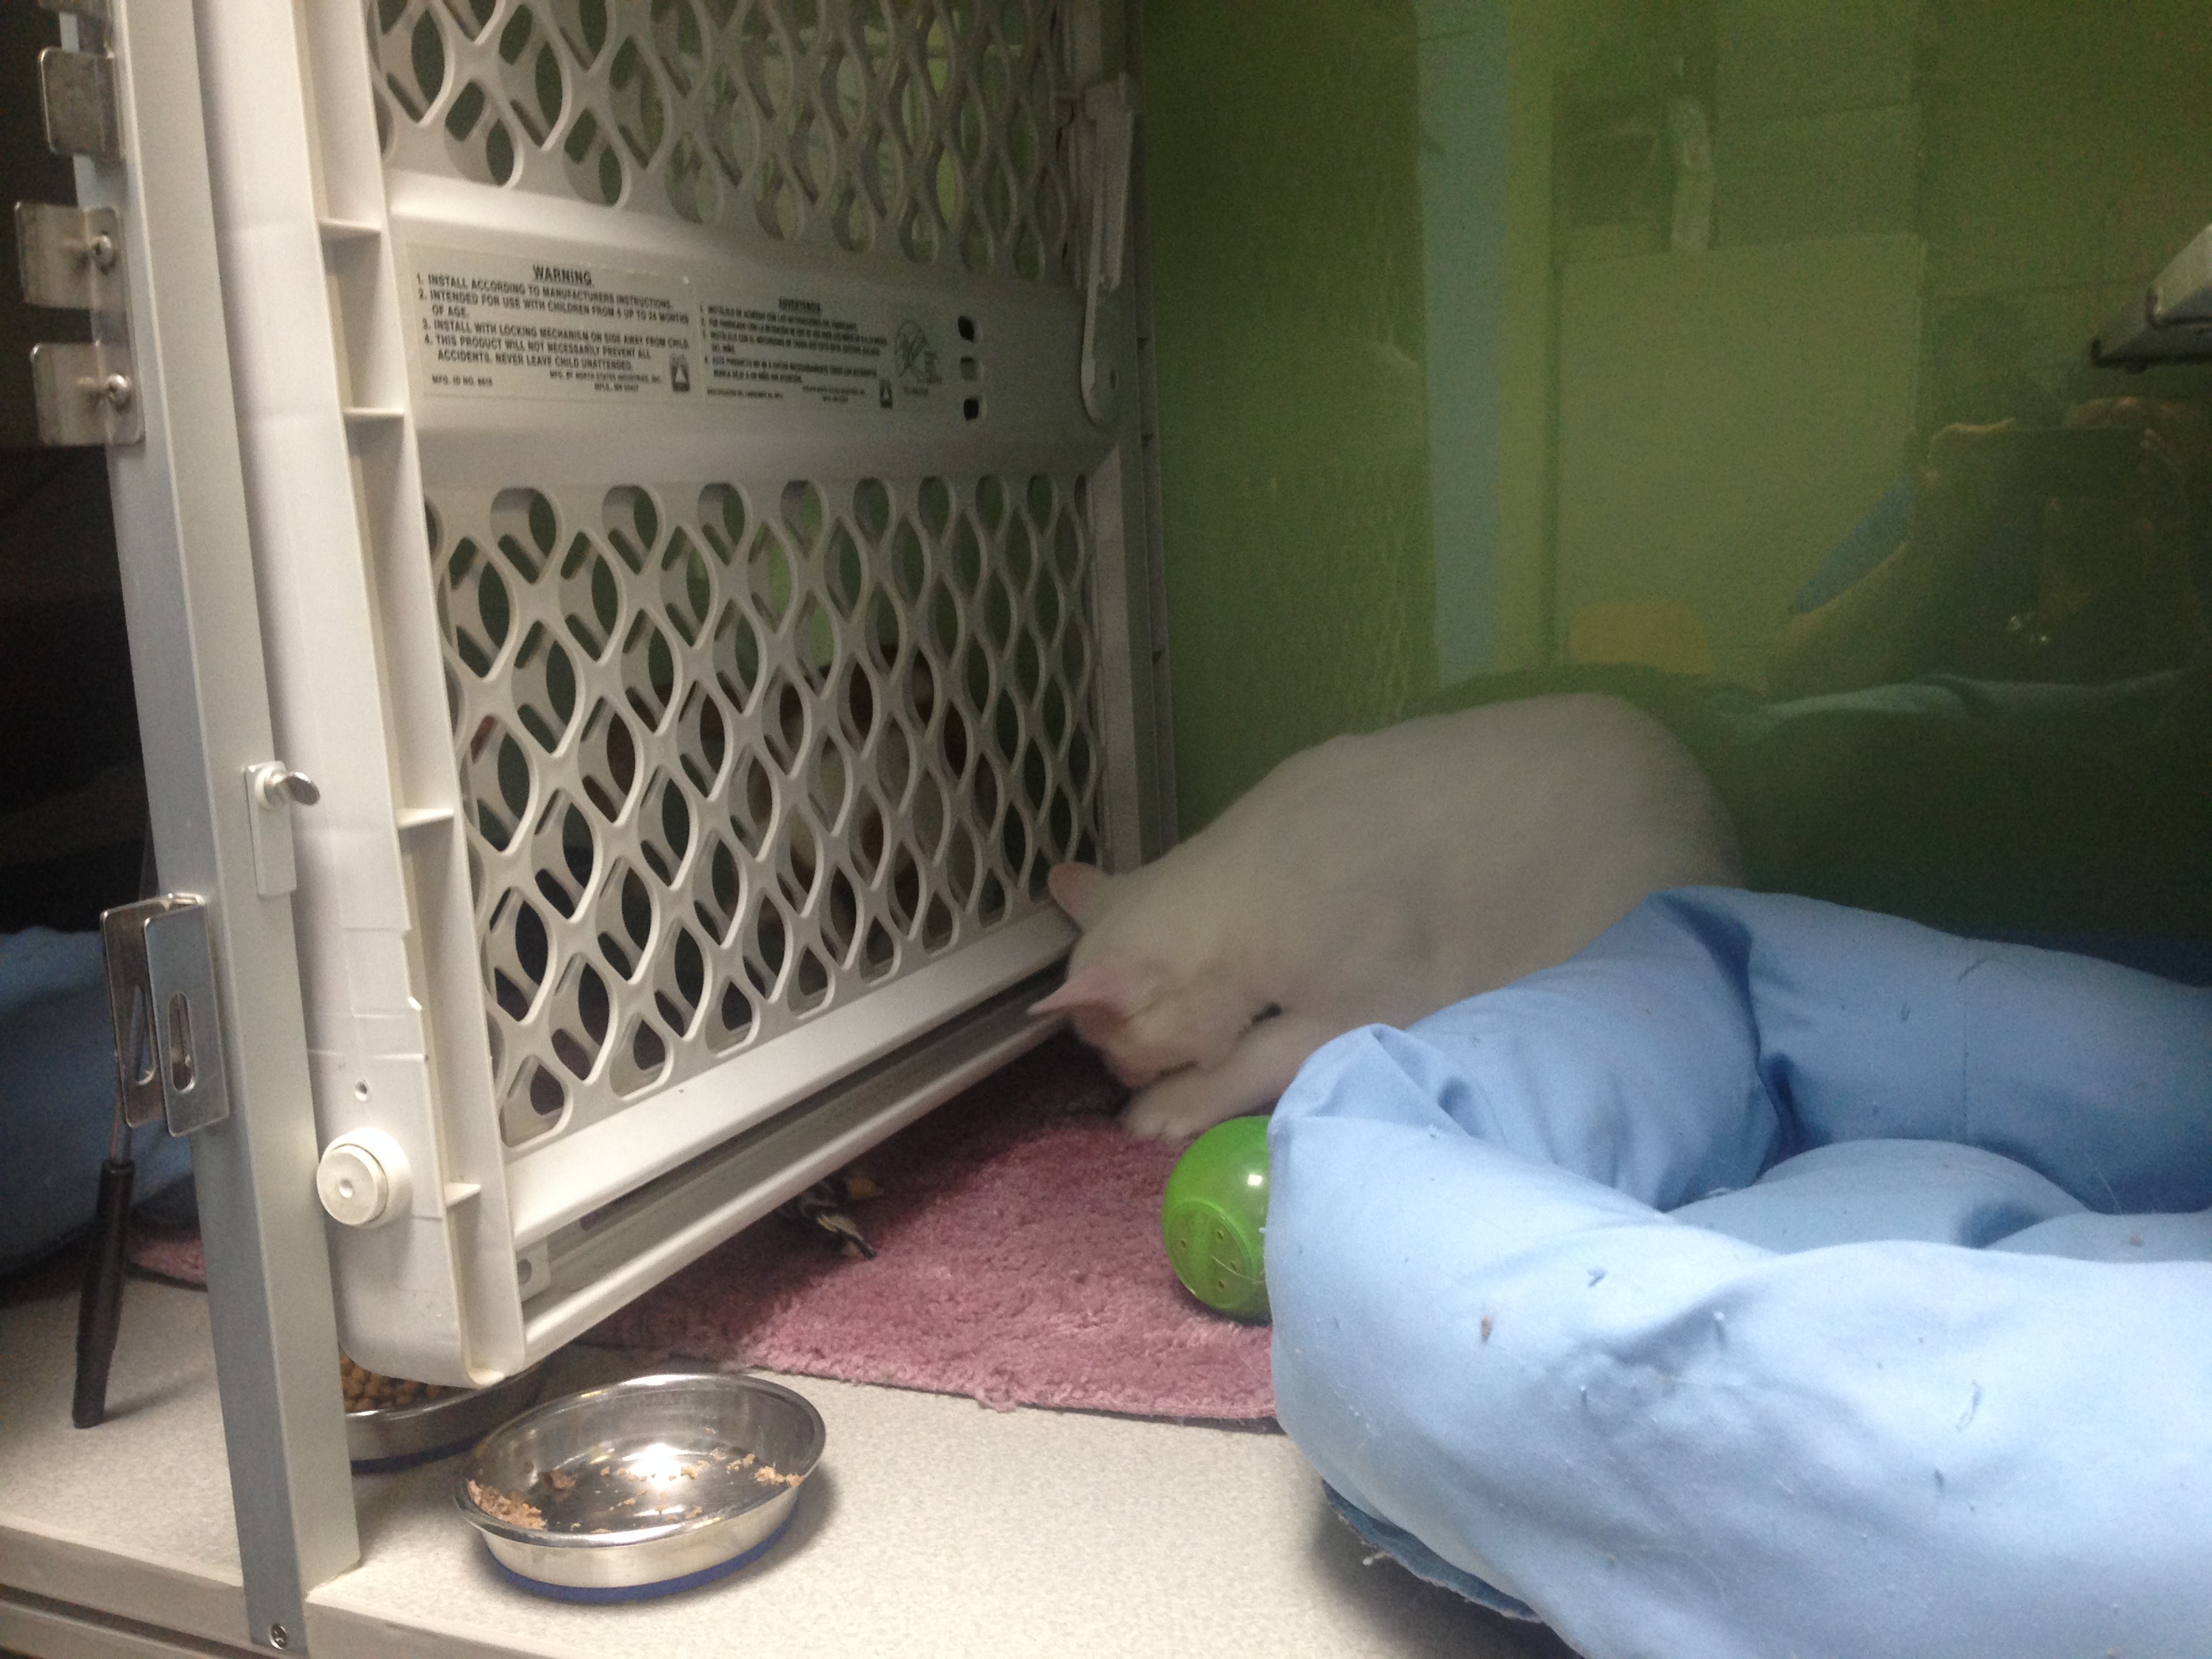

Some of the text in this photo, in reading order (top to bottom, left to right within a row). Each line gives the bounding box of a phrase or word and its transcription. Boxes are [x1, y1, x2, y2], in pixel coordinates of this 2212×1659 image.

[533, 264, 592, 285] WARNING
[428, 274, 468, 289] INSTALL
[471, 279, 525, 295] ACCORDING
[529, 284, 539, 297] TO
[543, 286, 614, 304] MANUFACTURERS
[430, 289, 478, 305] INTENDED
[481, 294, 499, 306] FOR
[503, 296, 520, 309] USE
[523, 300, 545, 311] WITH
[548, 300, 589, 314] CHILDREN
[592, 305, 614, 317] FROM
[623, 308, 634, 320] UP
[637, 310, 646, 321] TO
[659, 311, 689, 325] MONTHS
[432, 304, 444, 316] OF
[434, 319, 472, 333] INSTALL
[474, 321, 496, 334] WITH
[499, 323, 537, 337] LOCKING
[539, 327, 589, 342] MECHANISM
[591, 330, 602, 342] ON
[604, 333, 621, 344] SIDE
[623, 334, 642, 345] AWAY
[645, 336, 665, 348] FROM
[436, 335, 457, 347] THIS
[459, 335, 501, 350] PRODUCT
[504, 337, 525, 352] WILL
[527, 340, 544, 352] NOT
[547, 342, 600, 355] NECESSARILY
[602, 346, 635, 359] PREVENT
[638, 348, 651, 360] ALL
[495, 352, 523, 365] NEVER
[527, 354, 552, 367] LEAVE
[555, 355, 579, 368] CHILD
